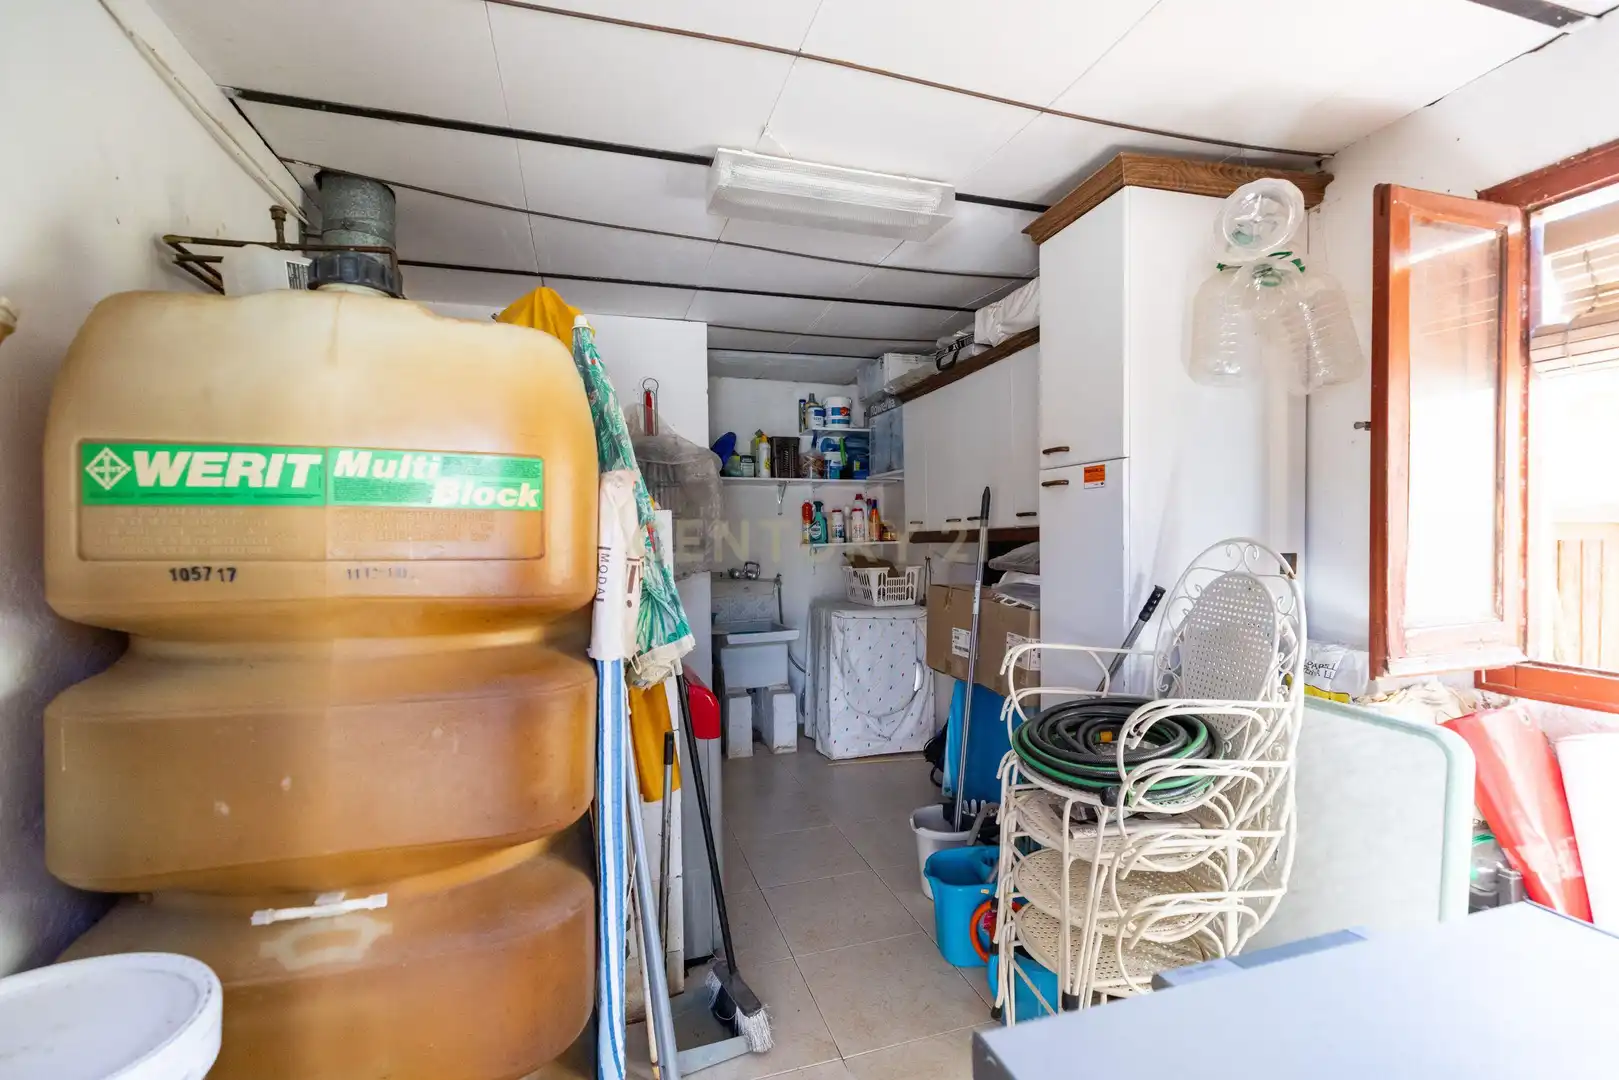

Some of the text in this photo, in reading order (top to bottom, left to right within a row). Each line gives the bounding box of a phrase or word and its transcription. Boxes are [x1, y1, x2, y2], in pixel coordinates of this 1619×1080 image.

[132, 450, 323, 488] WERIT
[334, 449, 441, 480] Multi
[431, 478, 540, 508] Block
